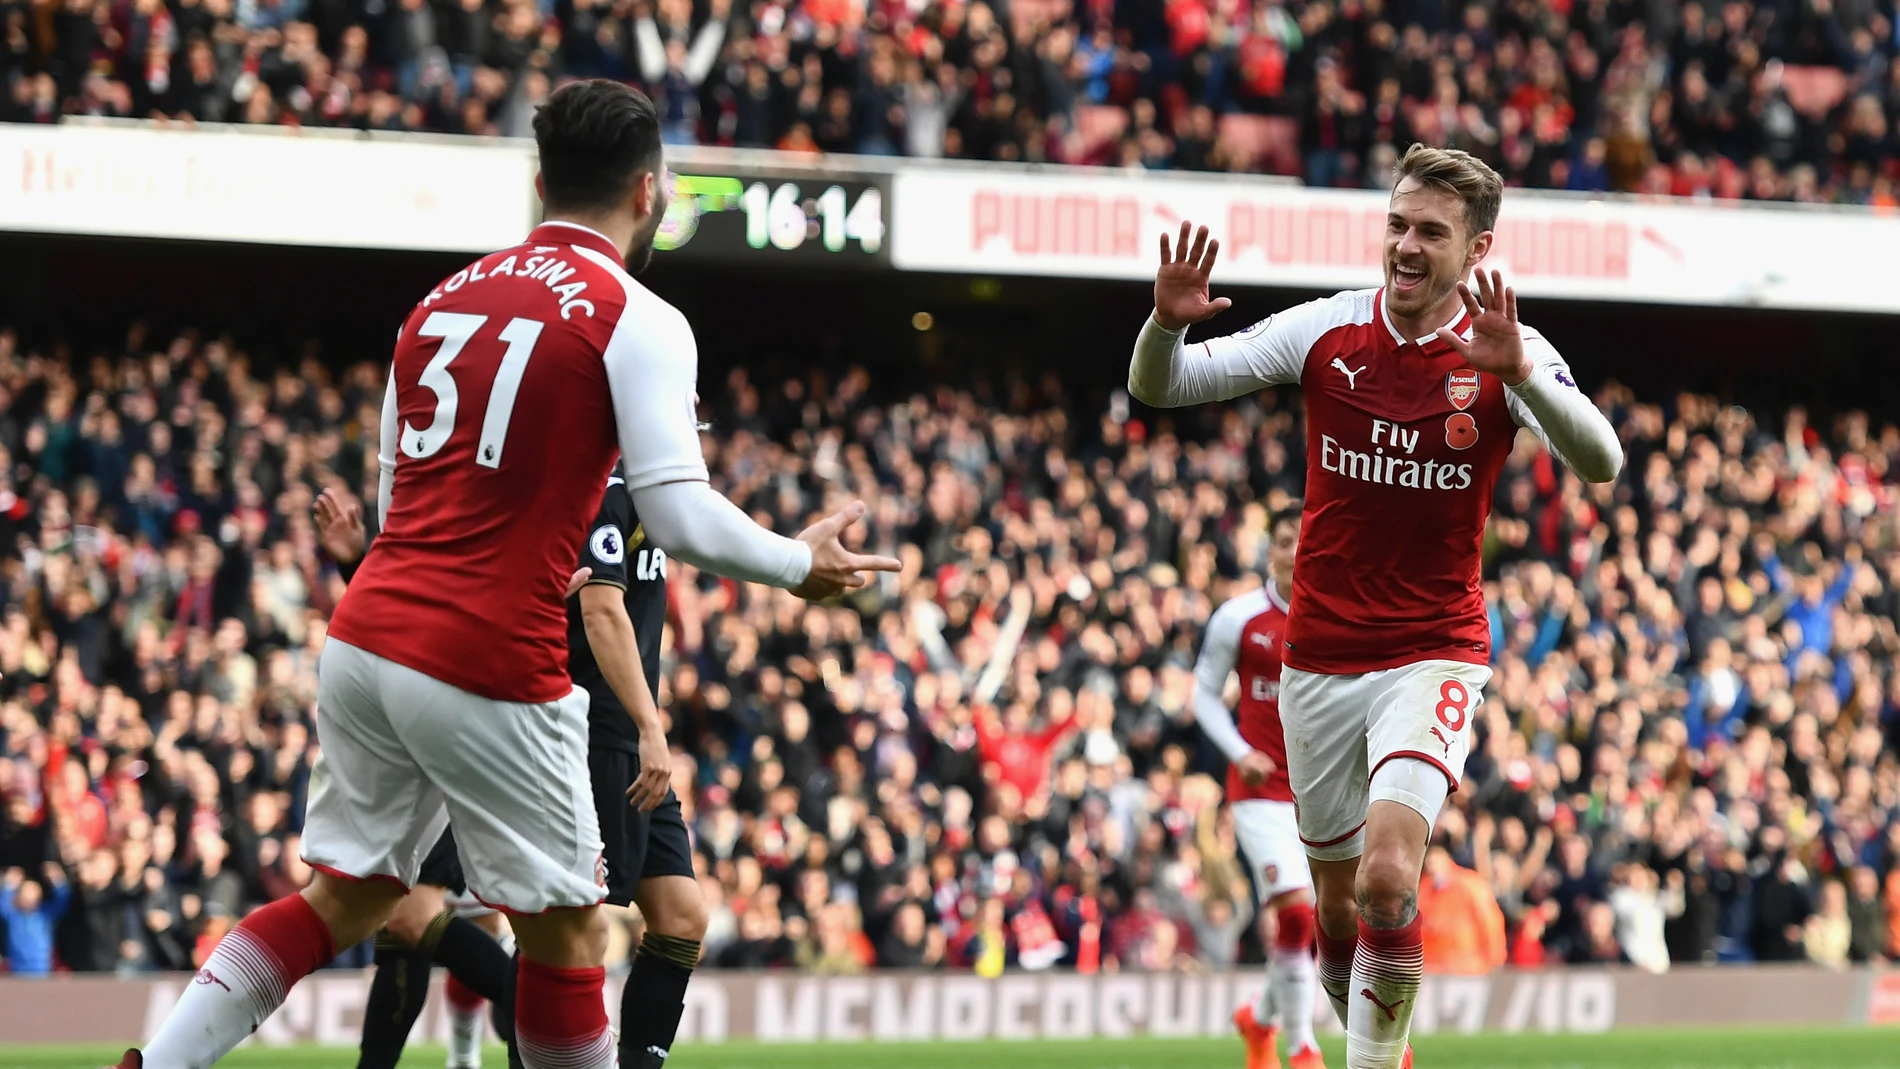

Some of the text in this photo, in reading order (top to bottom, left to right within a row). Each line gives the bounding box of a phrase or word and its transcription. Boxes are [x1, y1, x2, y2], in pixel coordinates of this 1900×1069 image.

[739, 182, 884, 254] 16:14
[973, 192, 1140, 258] PUMA
[1496, 219, 1629, 280] UMA
[423, 255, 596, 321] KOLASINAC
[400, 311, 545, 470] 31
[1449, 375, 1477, 383] Arsenal
[1321, 434, 1473, 490] Emirates
[1371, 419, 1420, 454] Fly
[1435, 680, 1469, 732] 8
